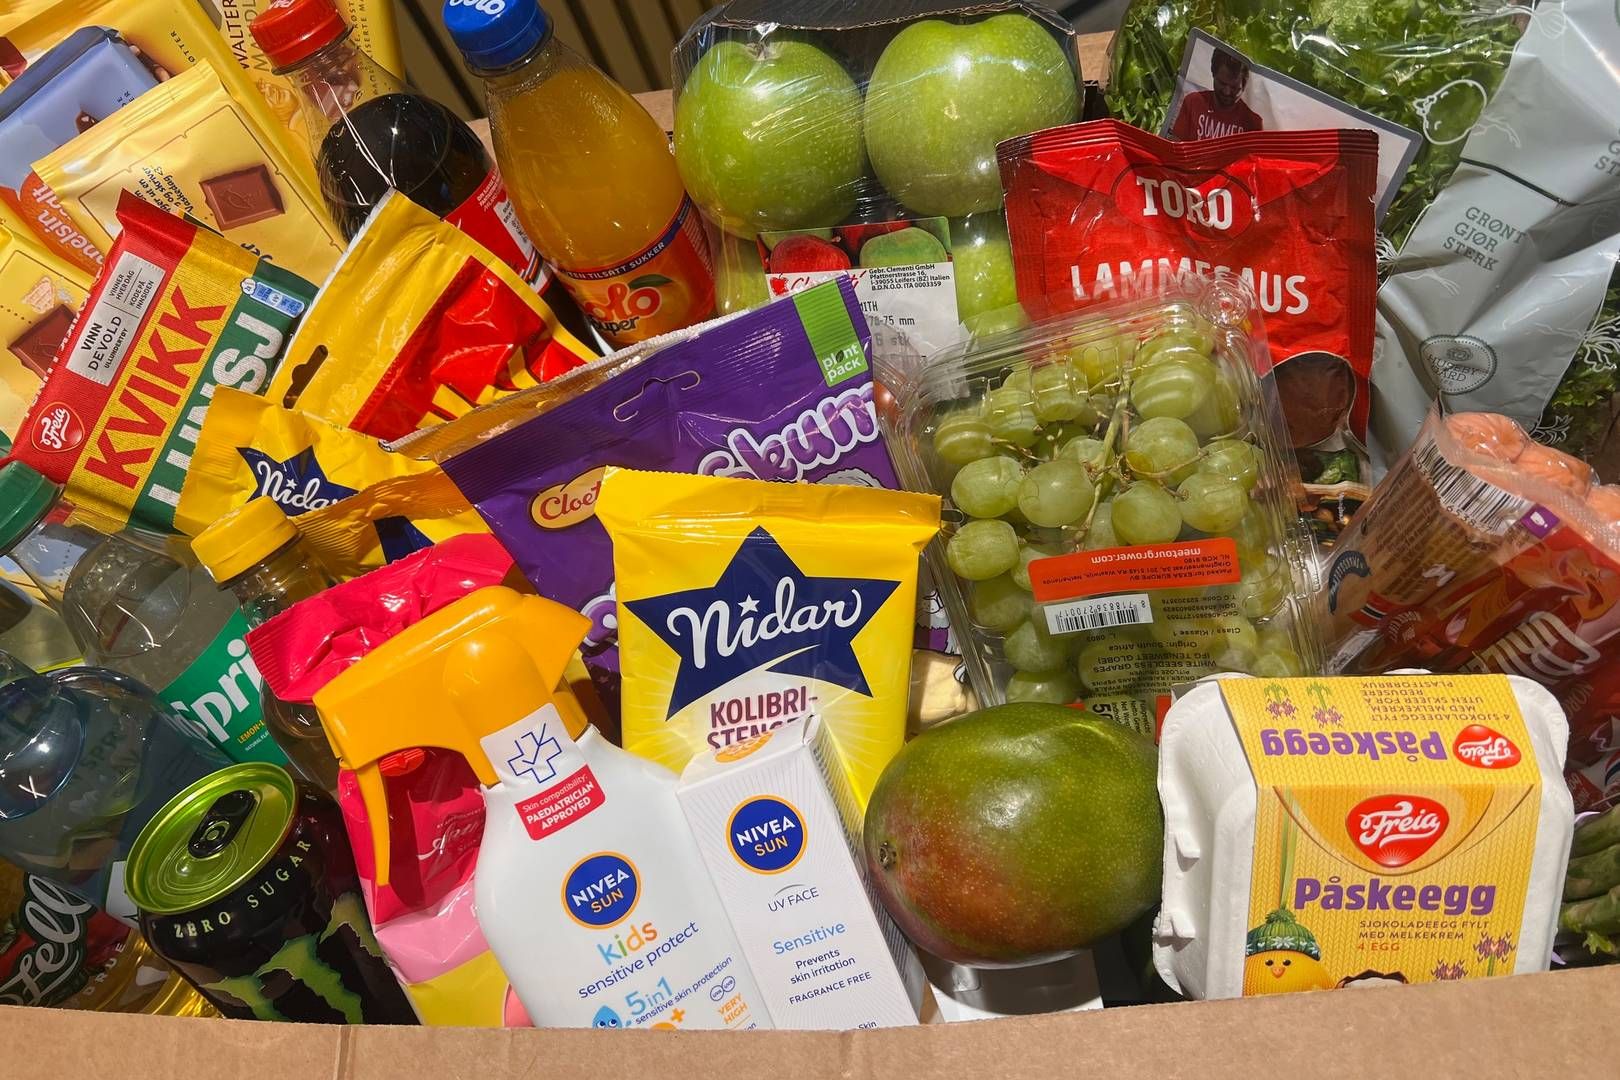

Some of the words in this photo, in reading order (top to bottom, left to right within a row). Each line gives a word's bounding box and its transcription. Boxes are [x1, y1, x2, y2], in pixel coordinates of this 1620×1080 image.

[1136, 175, 1233, 230] TORO
[1454, 222, 1500, 253] GJØR
[1465, 206, 1527, 245] GRØNT
[589, 265, 627, 280] TILSATT
[630, 241, 666, 269] SUKKER
[1442, 237, 1499, 272] STERK
[108, 273, 125, 298] VINNER
[115, 269, 136, 301] HVERDAG
[135, 280, 155, 310] INNSIDEN
[80, 322, 103, 352] VINN
[899, 317, 916, 326] mm
[87, 315, 122, 371] DEVOLD
[826, 357, 863, 382] pack
[84, 284, 229, 490] KVIKK
[40, 406, 68, 450] Freia
[256, 460, 338, 511] Nida
[540, 480, 601, 521] Cloet
[1090, 548, 1201, 564] meetourgrower.com
[666, 576, 862, 669] Nidar
[170, 638, 262, 743] pri
[710, 685, 818, 729] KOLIBRI-
[1370, 704, 1445, 713] MELKEKREM
[1449, 704, 1476, 712] MED
[1263, 728, 1448, 763] Påskeegg
[1458, 736, 1514, 766] Freia
[522, 801, 540, 813] Skin
[526, 781, 595, 824] PAEDIATRICIAN
[541, 796, 592, 830] APPROVED
[736, 815, 796, 848] NIVEA
[1358, 802, 1440, 849] Freia
[754, 835, 789, 857] SUN
[246, 840, 312, 909] SUGAR
[571, 868, 630, 908] NIVEA
[591, 887, 625, 913] SUN
[768, 895, 786, 912] UV
[788, 887, 820, 907] FACE
[1294, 875, 1496, 914] Påskeegg
[173, 912, 232, 939] ZERO
[772, 922, 846, 955] Sensitive
[1359, 920, 1458, 929] SJOKOLADEEGG
[1461, 920, 1489, 928] FYLT
[1359, 931, 1385, 939] MED
[1390, 931, 1465, 940] MELKEKREM
[578, 960, 645, 999] sensitive
[646, 921, 699, 967] protect
[597, 922, 658, 966] kids
[795, 949, 841, 970] Prevents
[1358, 942, 1365, 951] 4
[1371, 942, 1400, 951] EGG
[790, 966, 816, 985] skin
[817, 955, 856, 977] irritation
[635, 1000, 674, 1025] sensitive
[674, 987, 692, 1006] skin
[692, 956, 733, 993] protection
[717, 992, 743, 1015] VERY
[789, 979, 846, 1005] FRAGRANCE
[848, 971, 872, 987] FREE
[723, 1003, 748, 1025] HIGH
